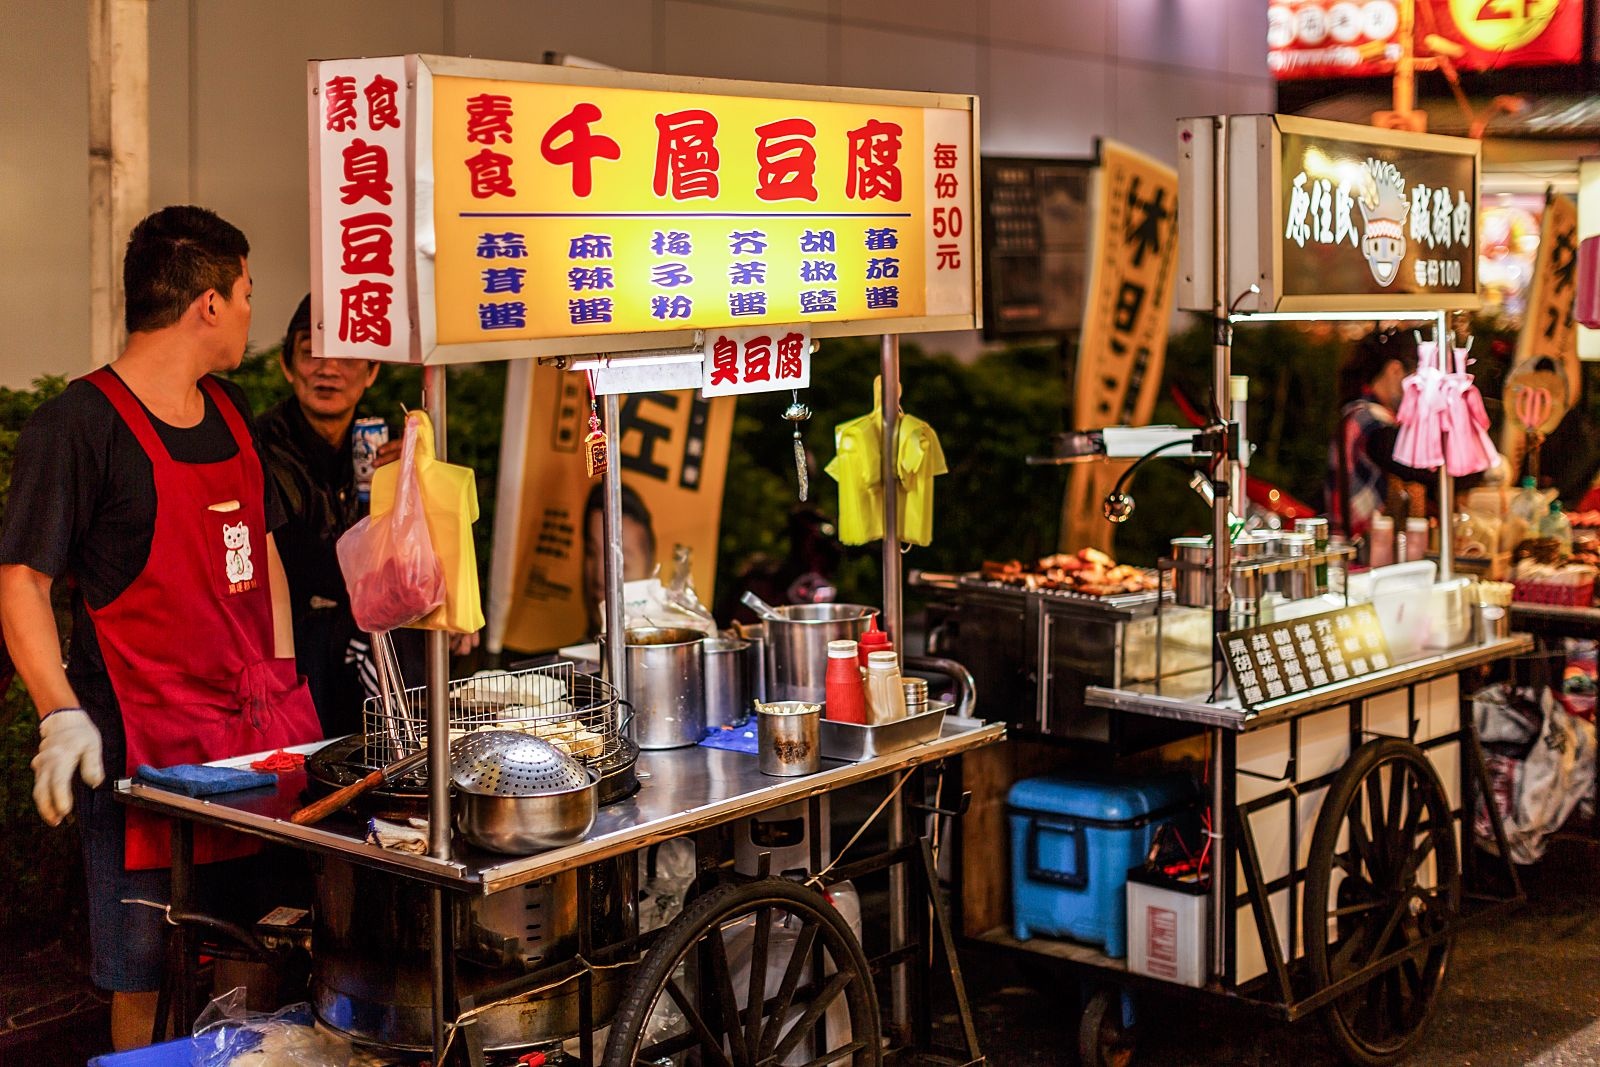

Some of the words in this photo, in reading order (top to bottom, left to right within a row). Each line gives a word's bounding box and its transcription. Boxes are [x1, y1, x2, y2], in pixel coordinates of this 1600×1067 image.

[325, 74, 401, 133] 素食
[465, 93, 517, 199] 素食
[540, 102, 904, 202] 千層豆腐
[338, 138, 394, 347] 臭豆腐
[932, 143, 963, 270] 每份50元
[568, 234, 614, 325] 麻辣醬
[651, 231, 694, 320] 梅子粉
[800, 230, 838, 314] 胡椒鹽
[710, 332, 805, 386] 臭豆腐
